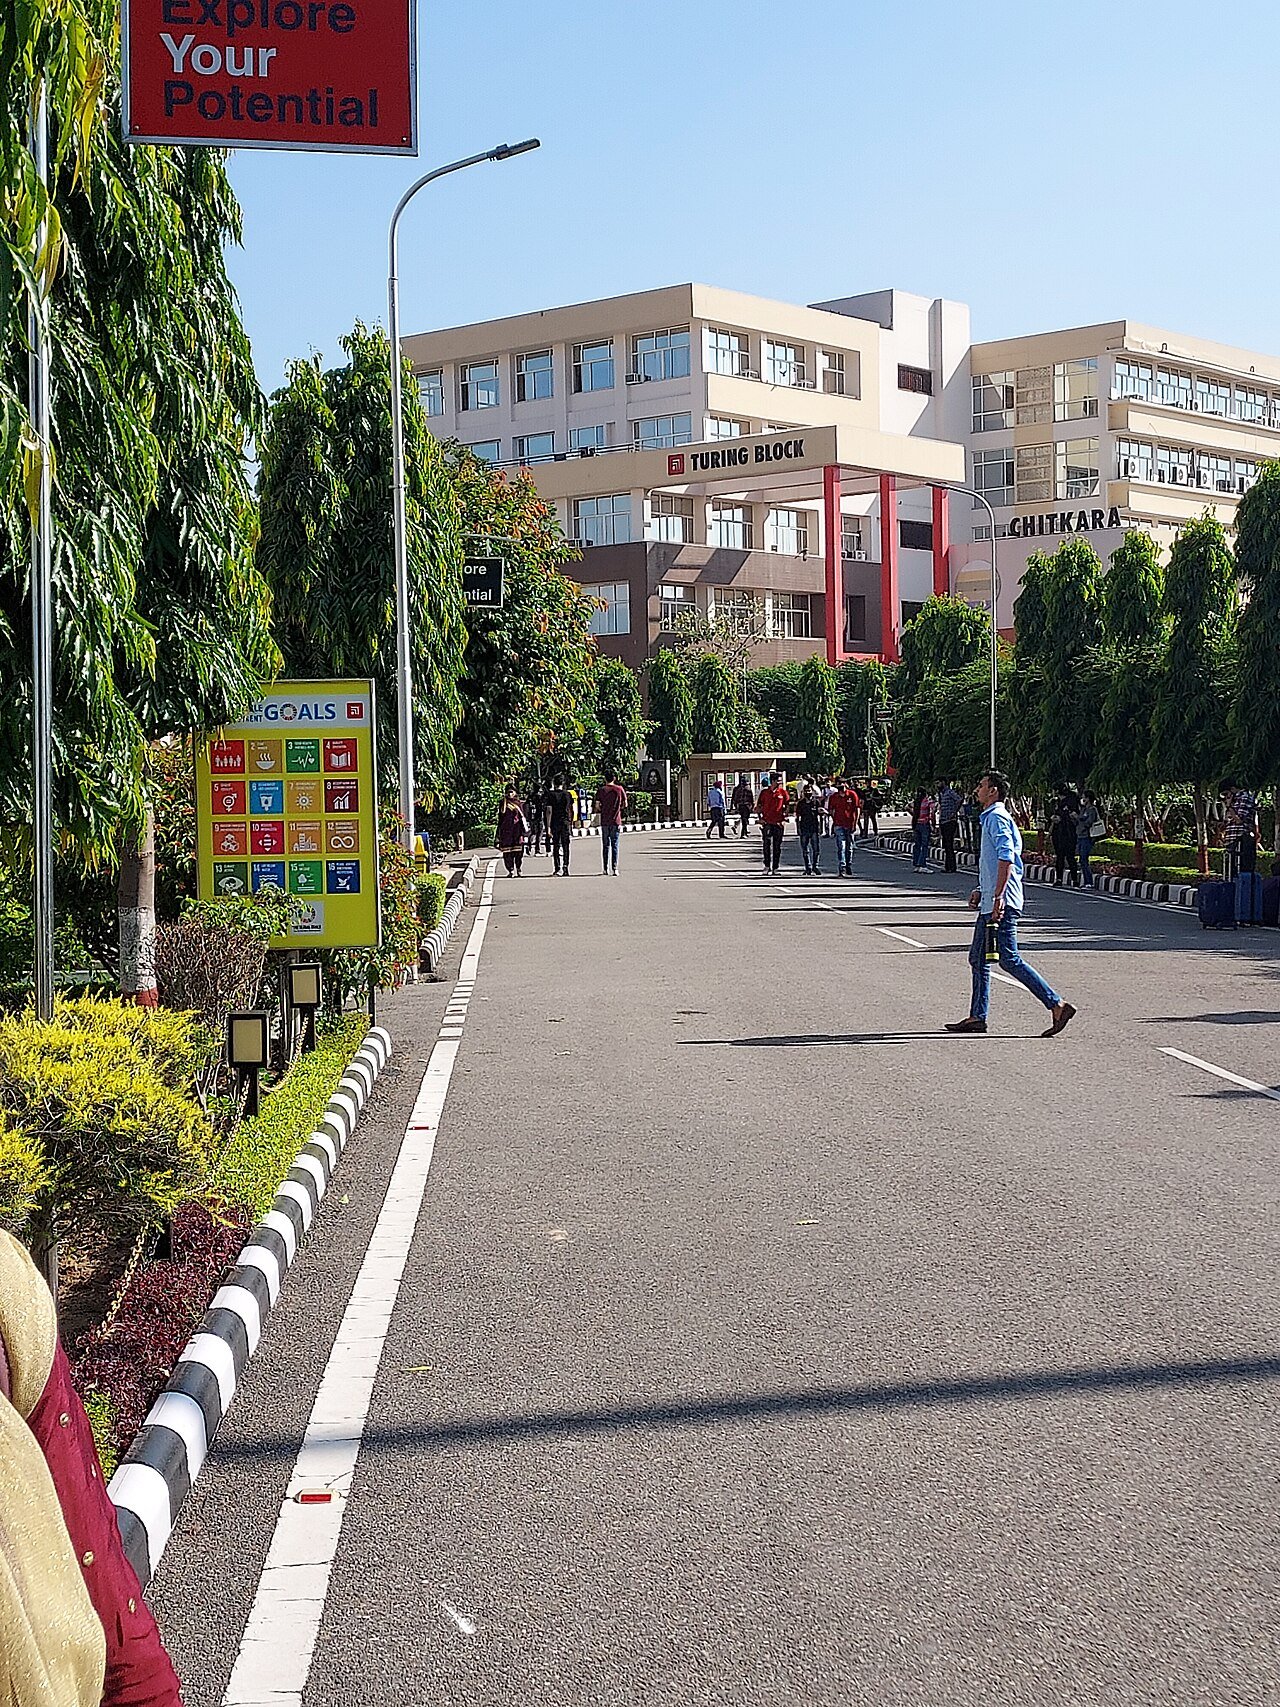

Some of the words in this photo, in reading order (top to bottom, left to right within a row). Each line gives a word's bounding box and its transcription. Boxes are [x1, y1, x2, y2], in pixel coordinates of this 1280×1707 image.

[162, 0, 356, 36] Explore
[160, 33, 277, 77] Your
[163, 80, 378, 128] Potential
[690, 447, 749, 471] TURING
[754, 439, 805, 463] BLOCK
[1009, 506, 1122, 537] CHITKARA
[463, 588, 492, 601] ntial
[263, 702, 337, 721] GOALS
